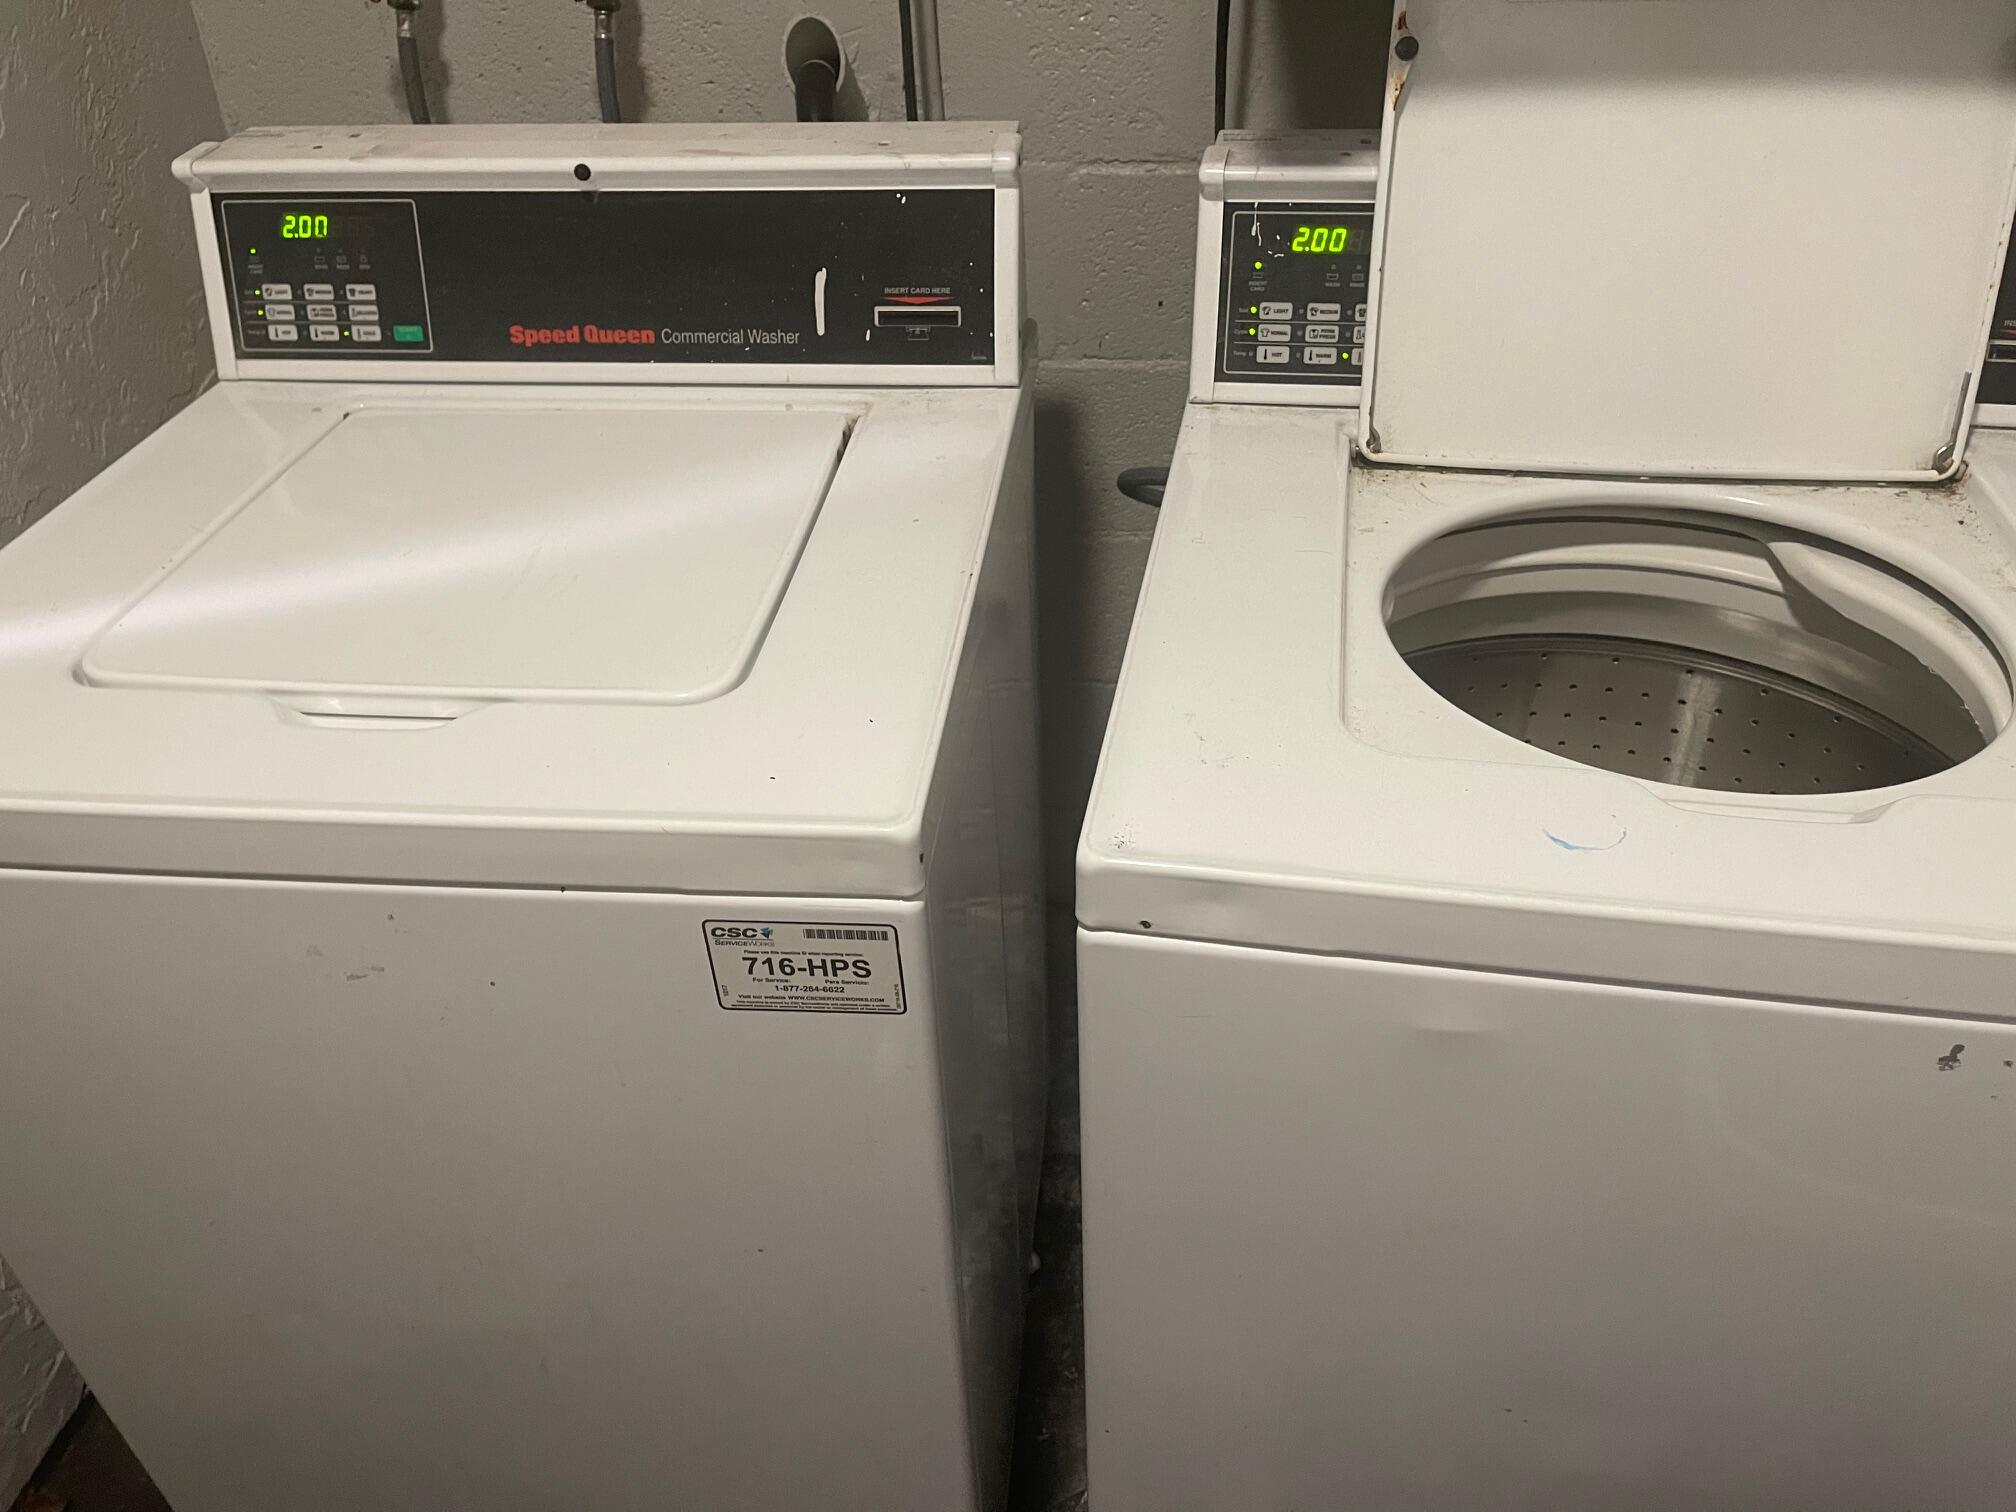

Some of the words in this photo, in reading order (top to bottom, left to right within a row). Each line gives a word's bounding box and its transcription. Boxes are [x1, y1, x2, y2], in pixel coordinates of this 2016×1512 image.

[282, 214, 328, 239] 2.00
[1292, 227, 1347, 253] 2.00
[884, 286, 908, 294] INSERT
[911, 286, 930, 294] CARD
[508, 324, 580, 347] Speed
[583, 324, 656, 345] Queen
[661, 327, 743, 345] Commercial
[747, 328, 800, 345] Washer
[711, 927, 757, 938] CSC
[742, 957, 871, 979] 716-HPS
[775, 985, 845, 994] 1-877-264-6622
